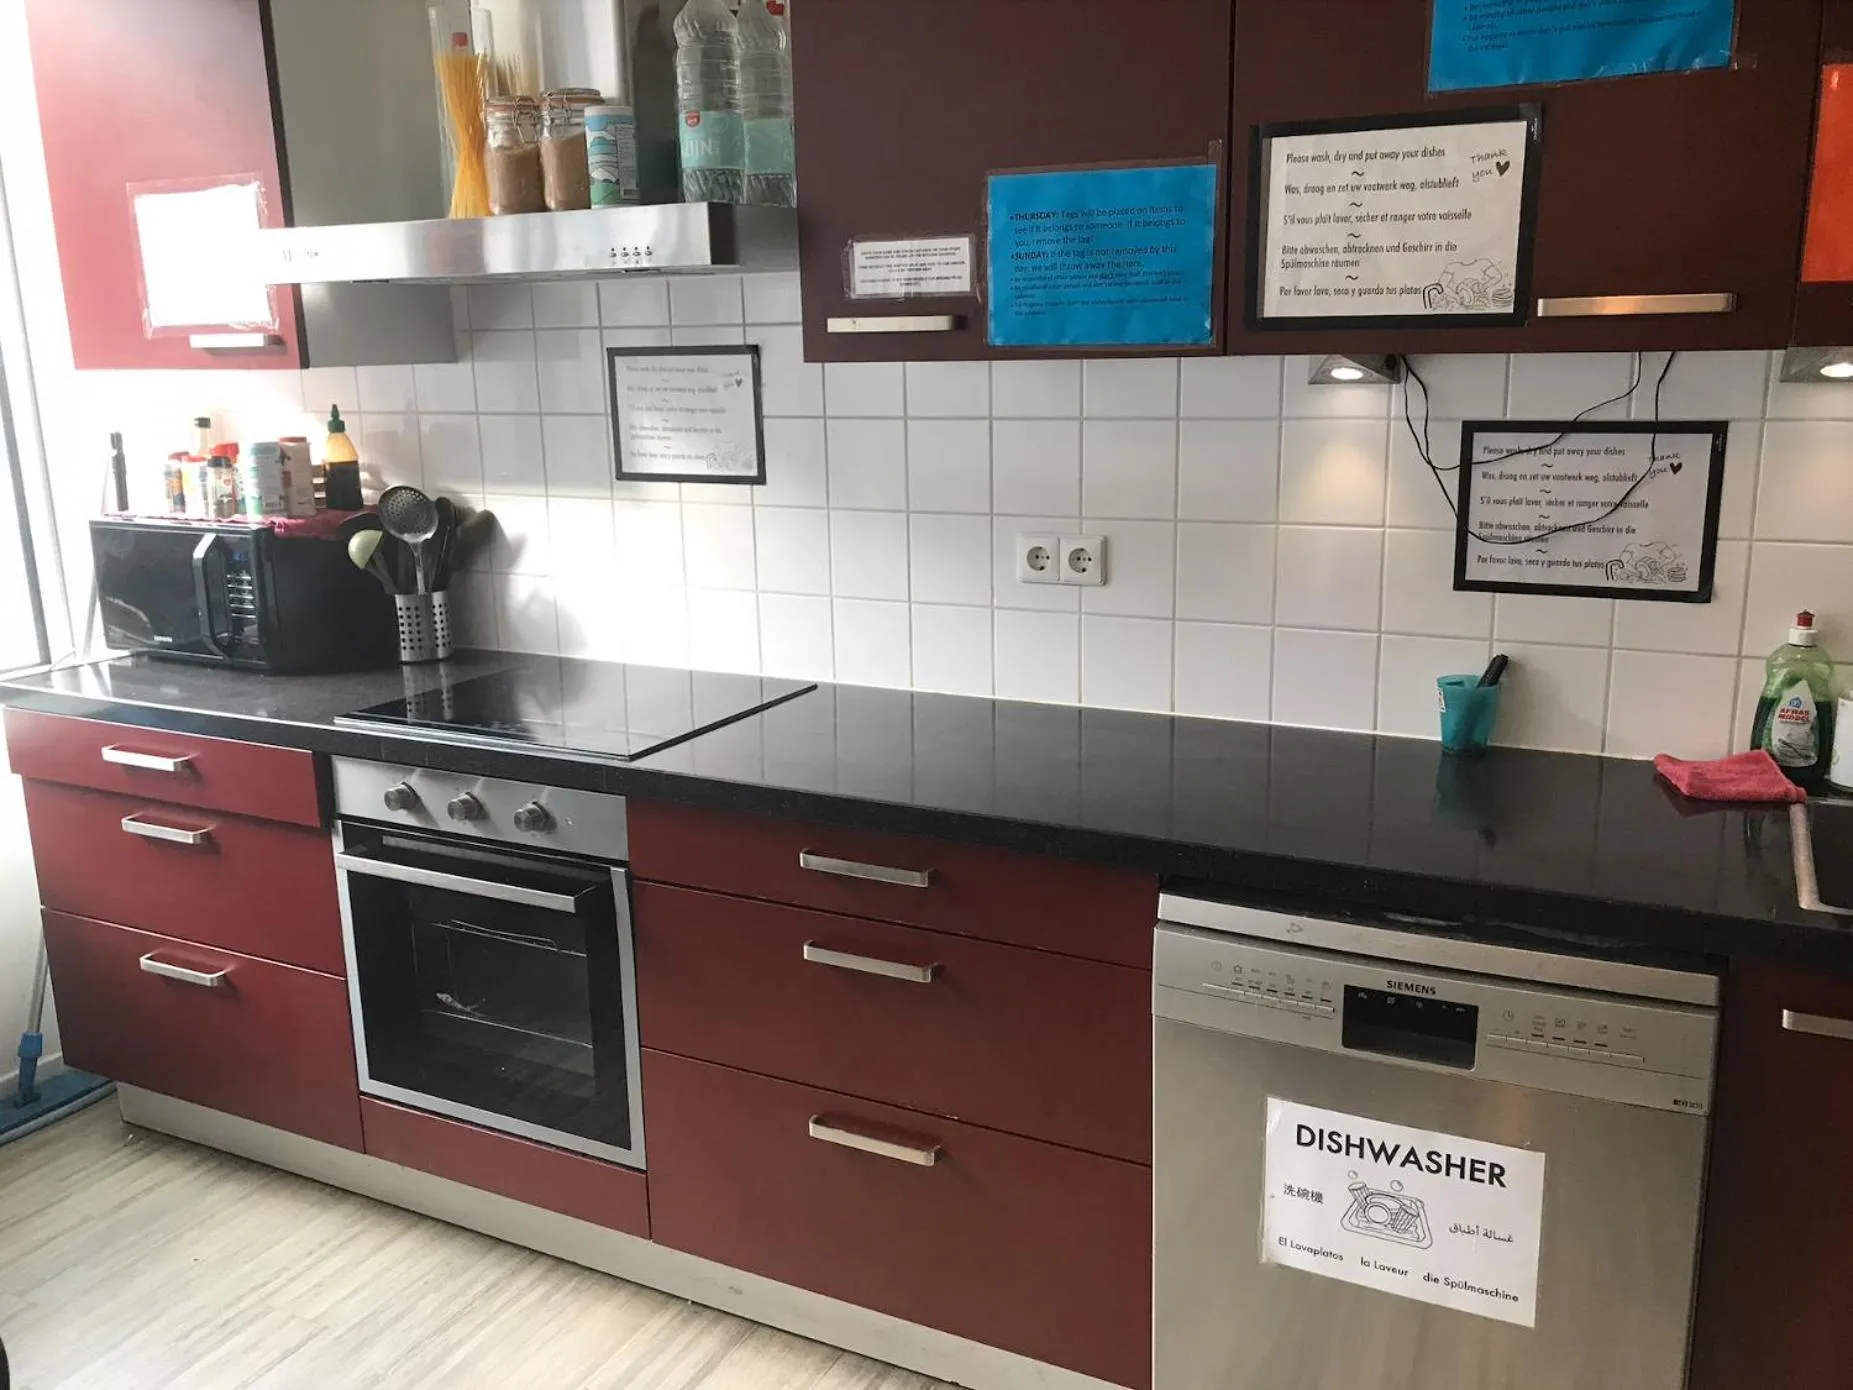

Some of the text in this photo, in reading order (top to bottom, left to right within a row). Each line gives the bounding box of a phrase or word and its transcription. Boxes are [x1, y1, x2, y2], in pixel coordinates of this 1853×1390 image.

[1286, 152, 1308, 163] Please
[1334, 151, 1347, 164] dry
[1349, 150, 1363, 160] and
[1365, 150, 1377, 162] put
[1380, 151, 1400, 162] away
[1402, 151, 1419, 161] your
[1421, 147, 1445, 157] dishes
[1015, 211, 1058, 220] THURSDAY:
[1380, 212, 1388, 222] et
[1386, 243, 1400, 253] und
[1435, 242, 1442, 252] in
[1445, 242, 1457, 252] die
[1554, 446, 1564, 458] put
[1567, 449, 1584, 458] away
[1604, 447, 1625, 456] dishes
[1387, 980, 1436, 995] SIEMENS
[1296, 1124, 1506, 1188] DISHWASHER
[1449, 1223, 1514, 1243] غسالة أطباق
[1278, 1236, 1519, 1302] El Lavaplatos la Laveur die Spülmaschine
